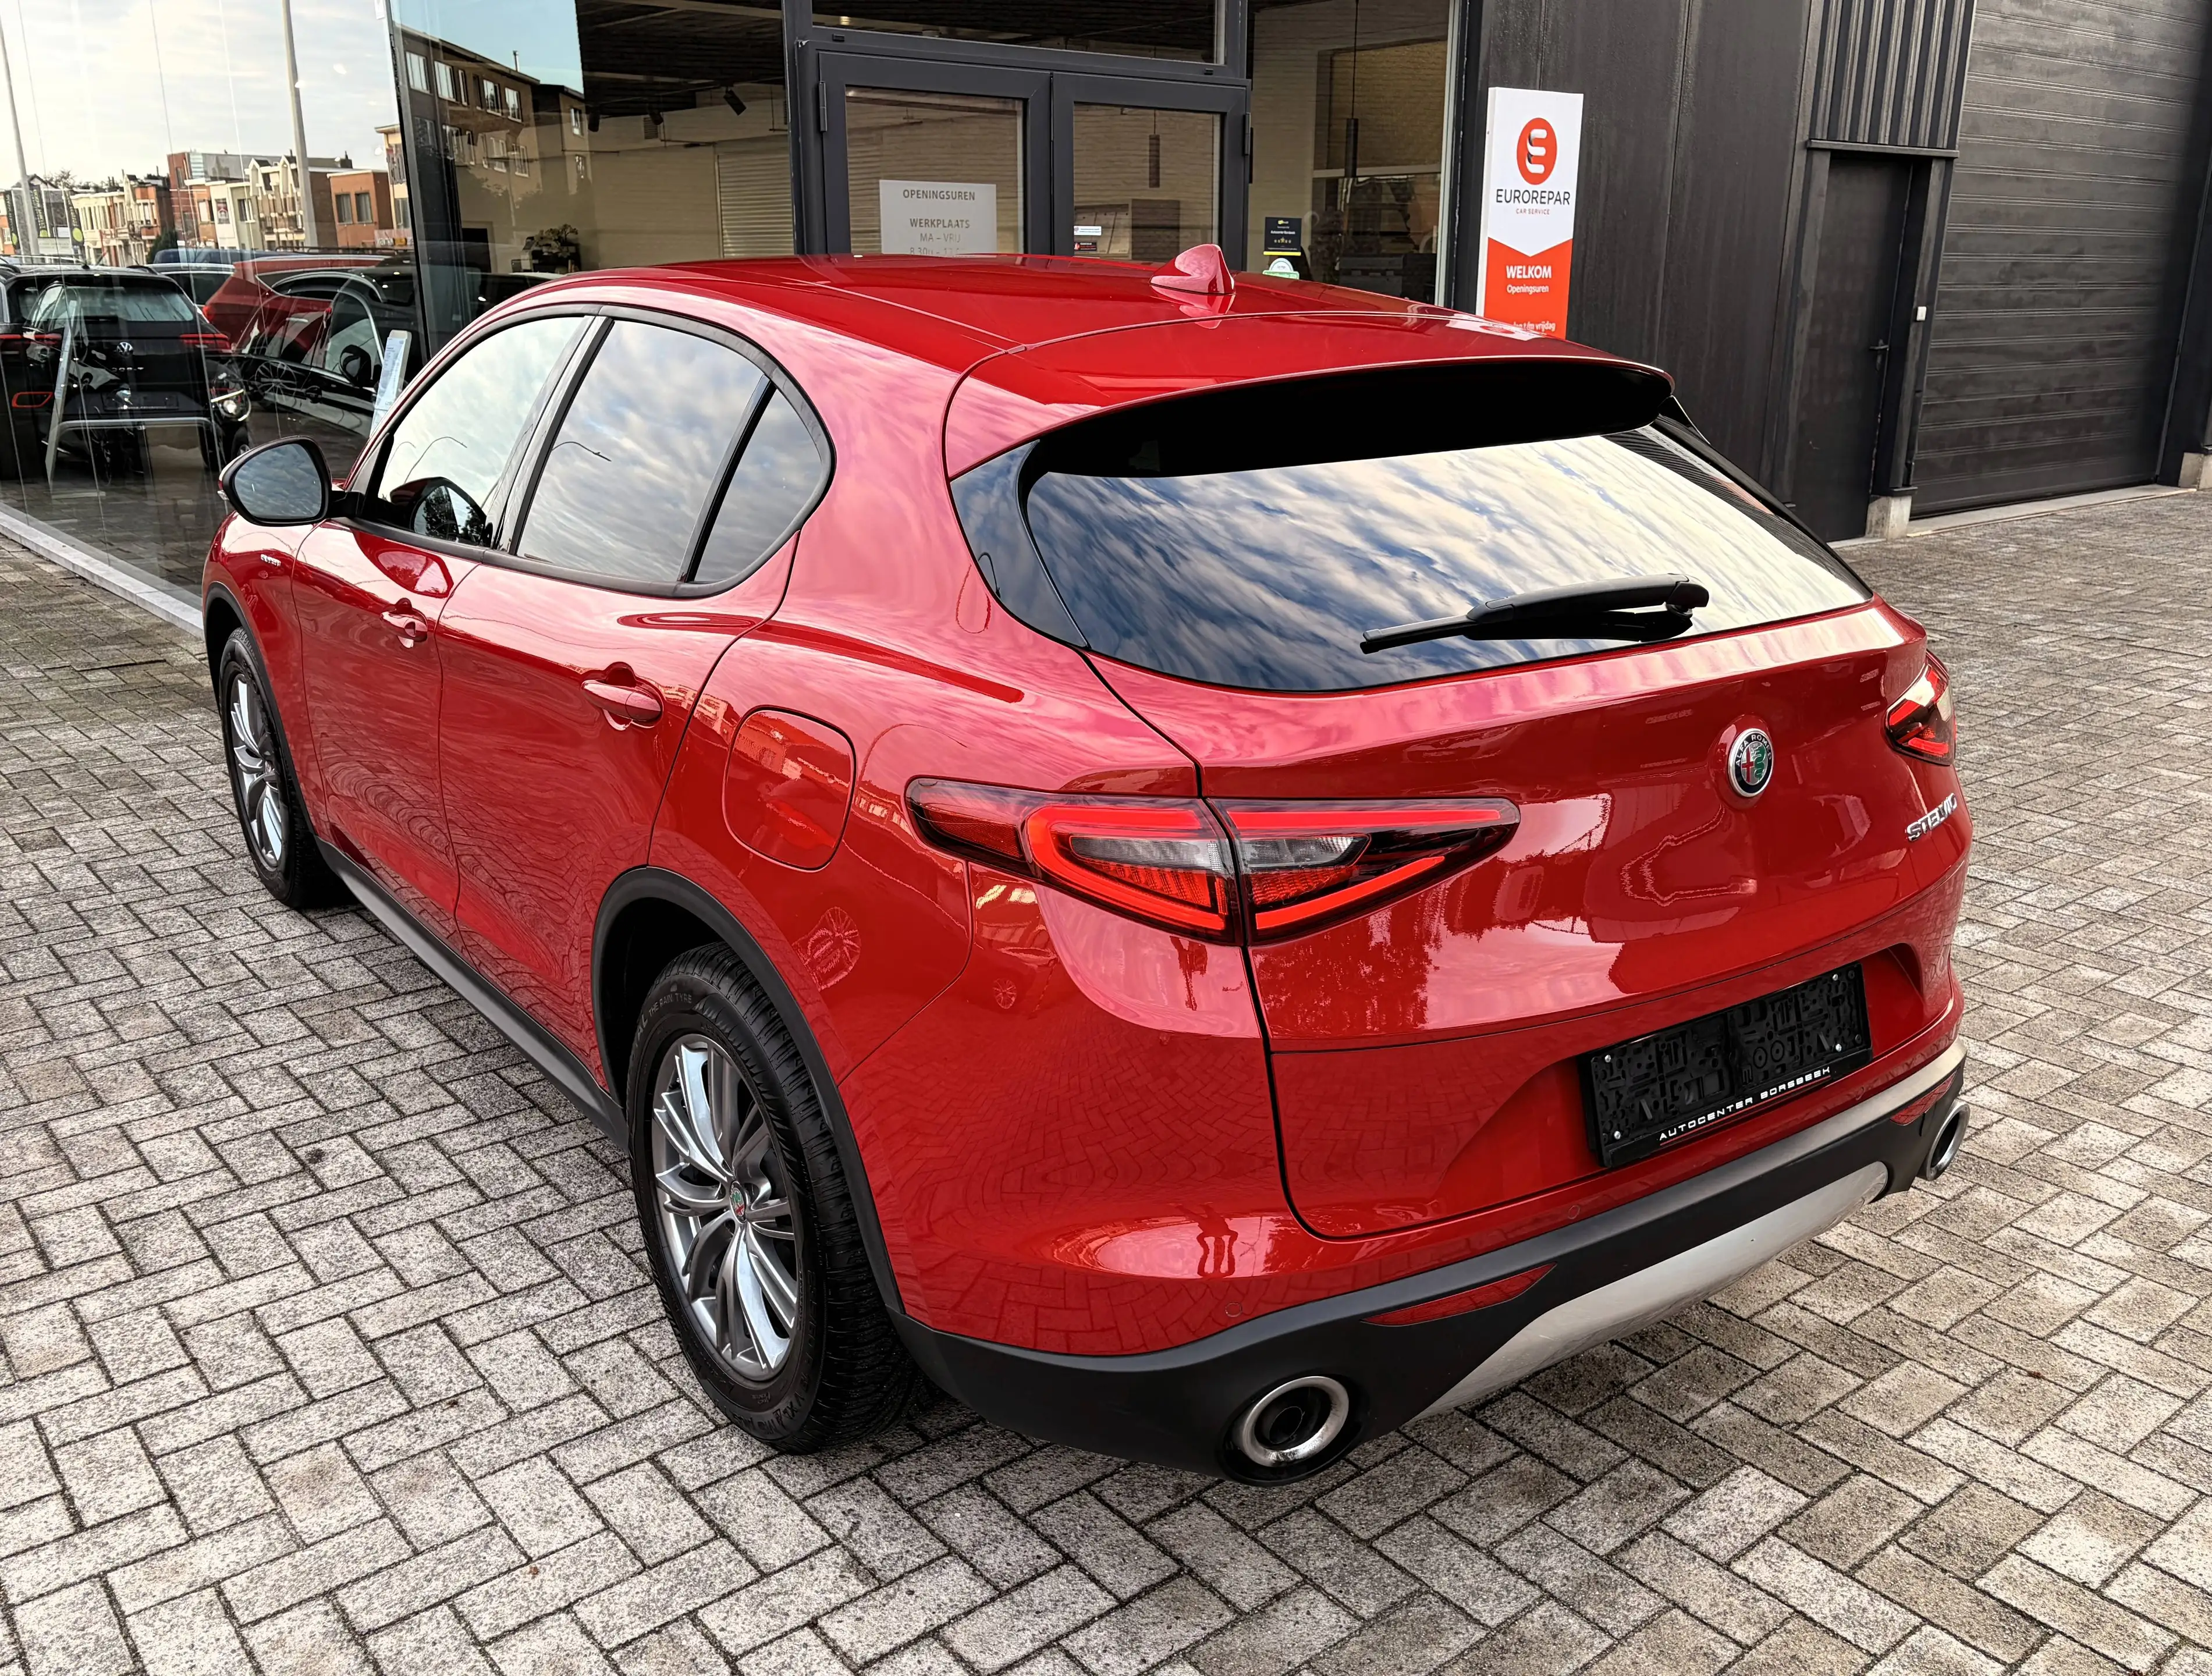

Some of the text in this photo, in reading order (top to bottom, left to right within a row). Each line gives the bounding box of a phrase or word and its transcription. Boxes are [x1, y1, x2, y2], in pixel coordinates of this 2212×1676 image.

[903, 189, 975, 201] OPENINGSUREN
[1496, 189, 1571, 205] EUROREPAR
[910, 218, 971, 229] WERKPLAATS
[920, 233, 934, 242] MA
[1506, 265, 1552, 279] WELKOM
[1506, 283, 1549, 295] Openingsuren
[1535, 321, 1556, 333] vrijdag
[1735, 734, 1771, 767] ALFA ROMEO
[1906, 792, 1958, 841] STELVIO
[648, 992, 693, 1017] THE RAIN TYRE
[1659, 1066, 1831, 1141] AUTOCENTER BORSBEEK
